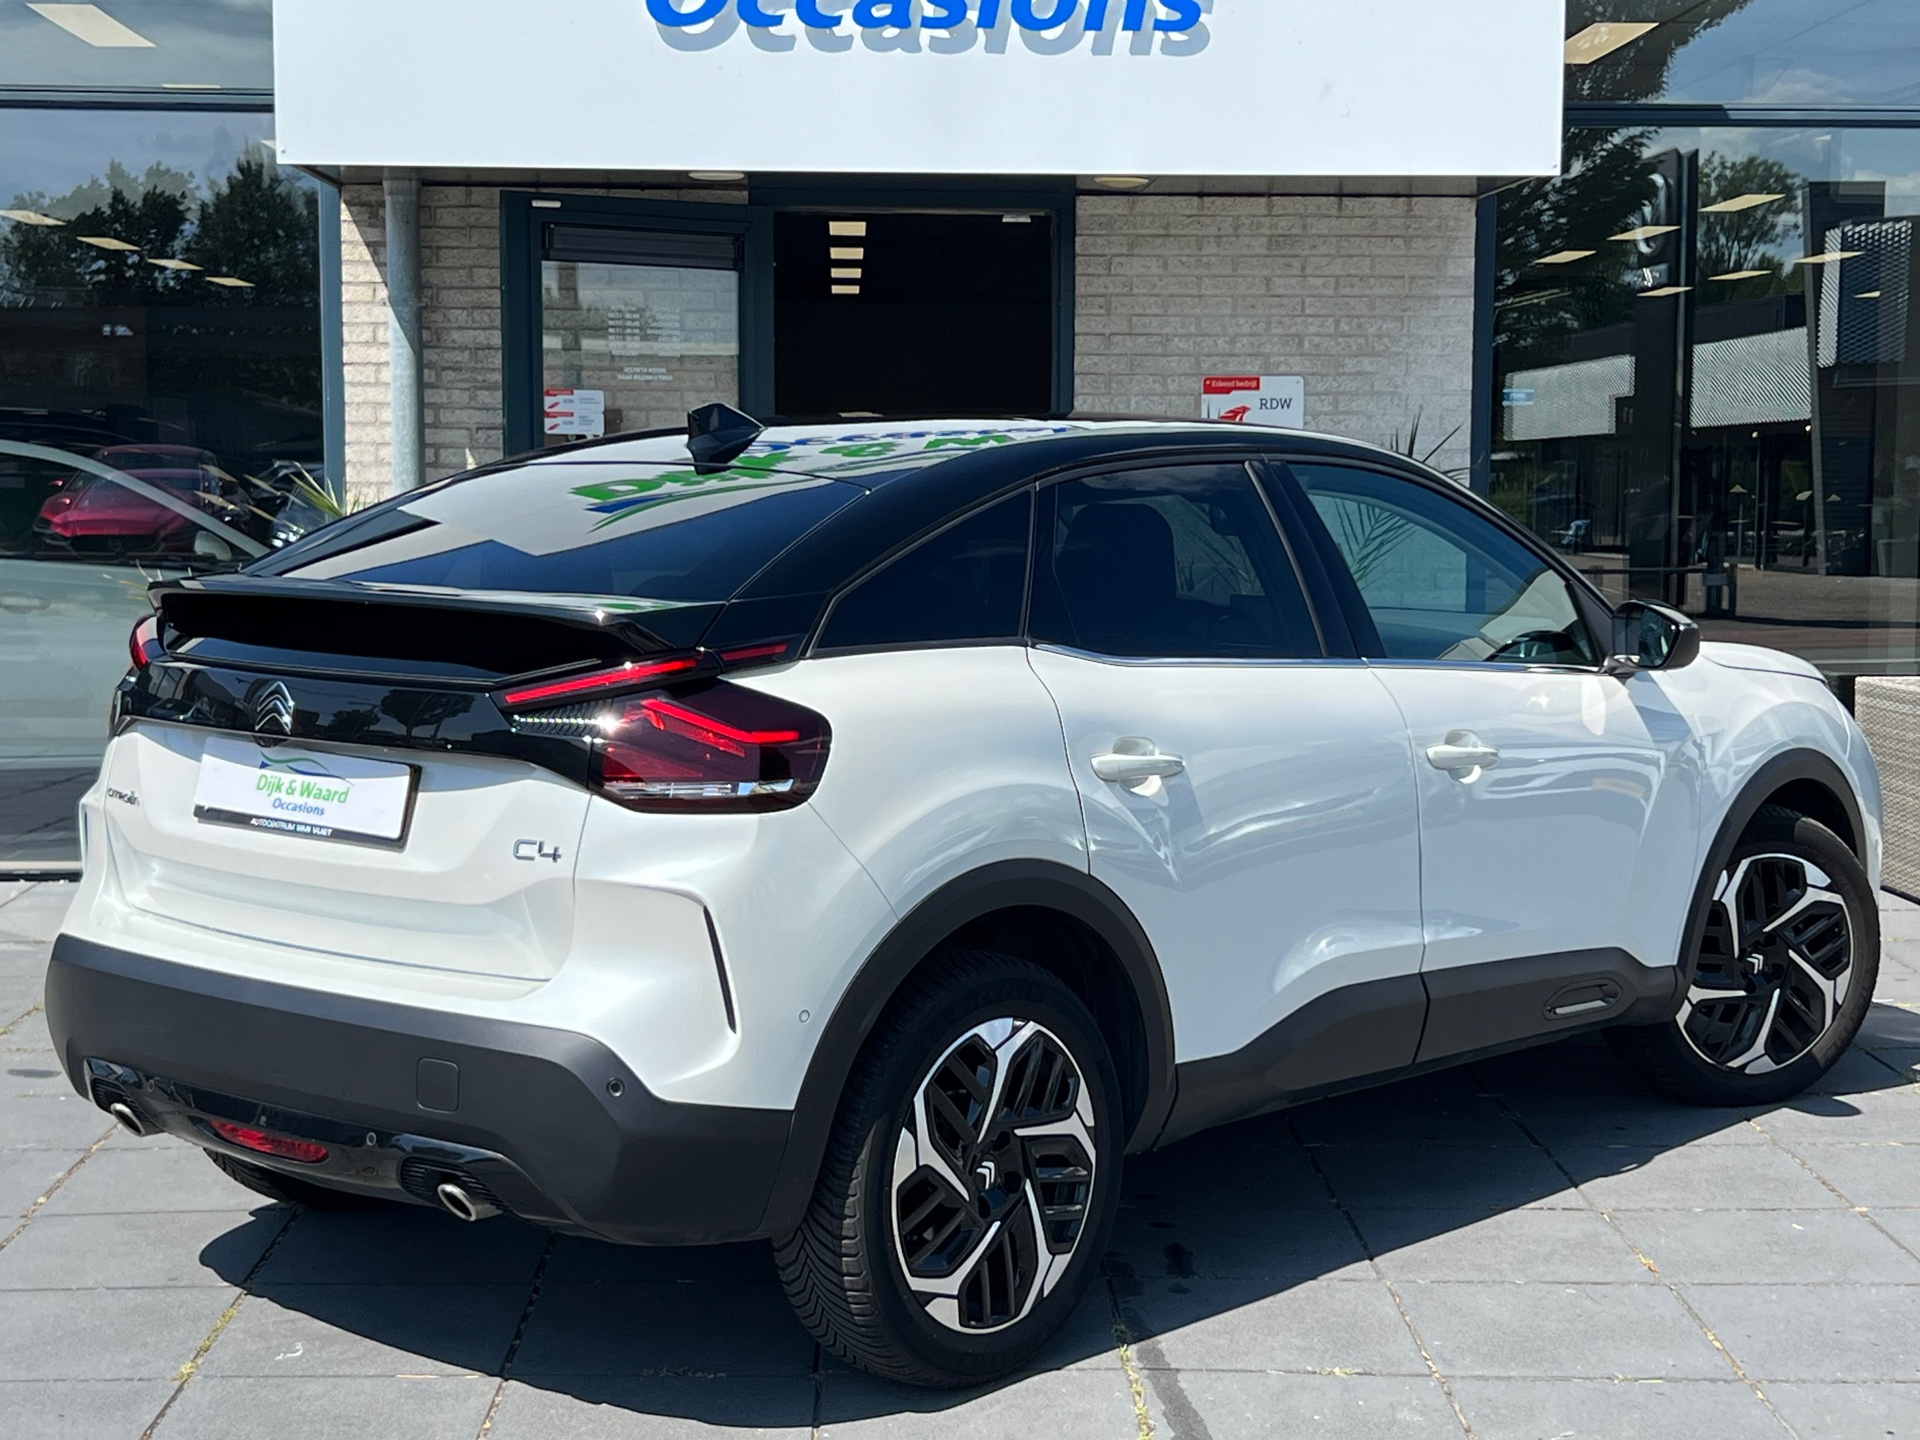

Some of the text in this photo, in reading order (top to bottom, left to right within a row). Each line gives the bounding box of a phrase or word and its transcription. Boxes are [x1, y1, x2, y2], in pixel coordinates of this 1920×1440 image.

[1259, 398, 1292, 410] RDW
[256, 774, 350, 804] Dijk & Waard
[272, 797, 326, 816] Occasions
[513, 838, 562, 863] C4
